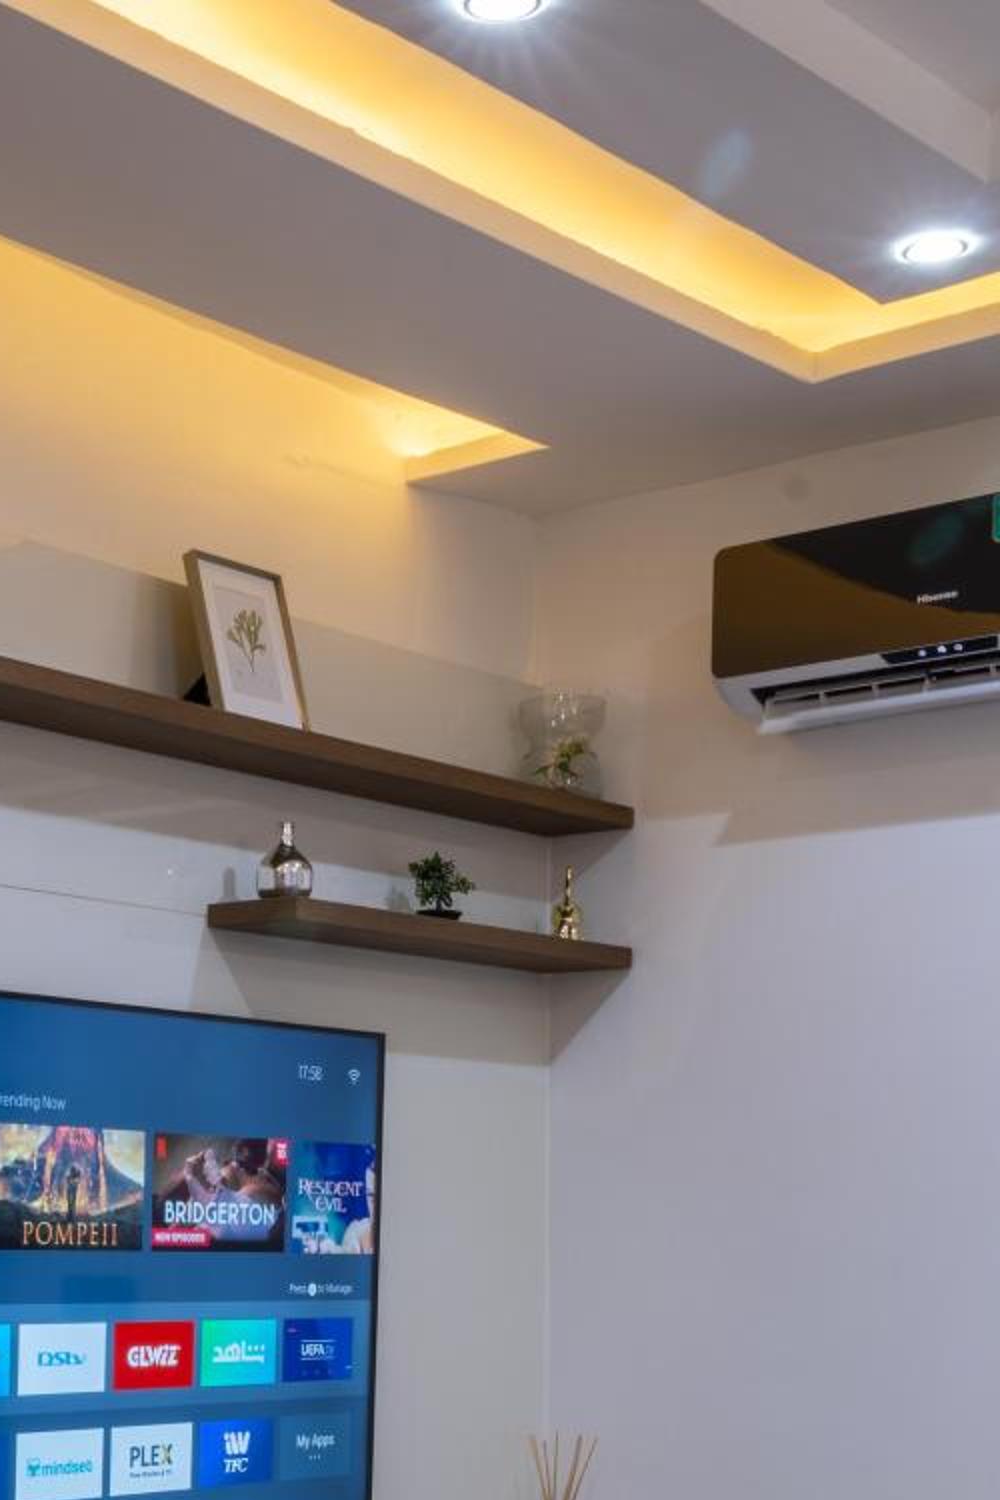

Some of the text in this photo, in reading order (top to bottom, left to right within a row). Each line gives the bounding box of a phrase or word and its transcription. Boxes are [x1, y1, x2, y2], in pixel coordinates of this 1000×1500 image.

[43, 1096, 66, 1111] Now
[298, 1178, 363, 1197] RESIDENT
[164, 1201, 275, 1225] BRIDGERTON
[315, 1198, 347, 1213] EVIL
[23, 1221, 118, 1246] POMPEII
[301, 1343, 325, 1357] UEFA
[296, 1434, 335, 1449] My Apps
[129, 1443, 172, 1468] PLEX
[41, 1459, 93, 1477] mindset
[224, 1458, 248, 1473] TFC
